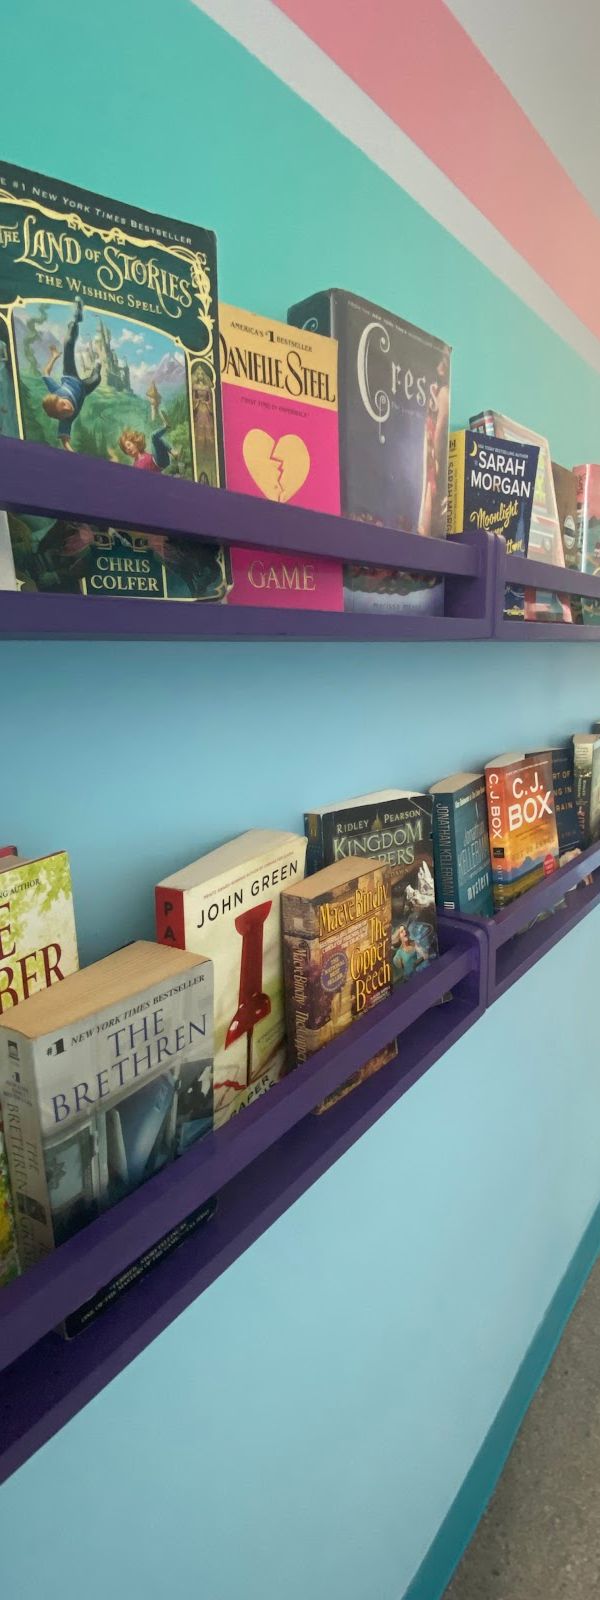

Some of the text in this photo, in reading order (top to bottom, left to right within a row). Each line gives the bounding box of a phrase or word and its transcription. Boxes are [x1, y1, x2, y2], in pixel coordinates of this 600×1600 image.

[32, 187, 58, 201] NEW
[63, 198, 90, 213] YORK
[95, 208, 126, 225] TIMES
[131, 219, 192, 246] BESTSELLER
[14, 215, 80, 273] LAND
[85, 248, 101, 264] OF
[97, 246, 192, 318] STORIES
[36, 272, 163, 315] THE WISHING SPELL
[276, 336, 313, 352] BESTSELLER
[285, 350, 336, 403] STEEL
[357, 322, 439, 424] Cress
[471, 470, 531, 498] MORGAN
[478, 451, 526, 477] SARAH
[470, 500, 518, 531] Moonlight
[90, 575, 159, 592] COLFER
[96, 557, 150, 573] CHRIS
[247, 560, 316, 591] GAME
[336, 809, 421, 834] RIDLEY PEARSON
[436, 803, 452, 847] JONATHAN
[491, 806, 503, 839] BOX
[508, 791, 553, 831] BOX
[333, 820, 423, 862] KINGDOM
[368, 845, 415, 867] PERS
[11, 878, 41, 895] AUTHOR
[439, 848, 454, 896] KELLERMAN
[197, 889, 243, 929] JOHN
[251, 860, 298, 896] GREEN
[319, 900, 354, 937] Maeve
[355, 880, 389, 918] Binchy
[370, 916, 388, 944] The
[351, 938, 389, 980] Copper
[292, 975, 308, 1006] Binchy
[355, 962, 391, 1013] Beech
[46, 974, 205, 1057] #1 NEW YORK TIMES BESTSELLER
[107, 1008, 165, 1057] THE
[51, 1014, 207, 1124] BRETHREN
[7, 1103, 27, 1192] BRETHREN
